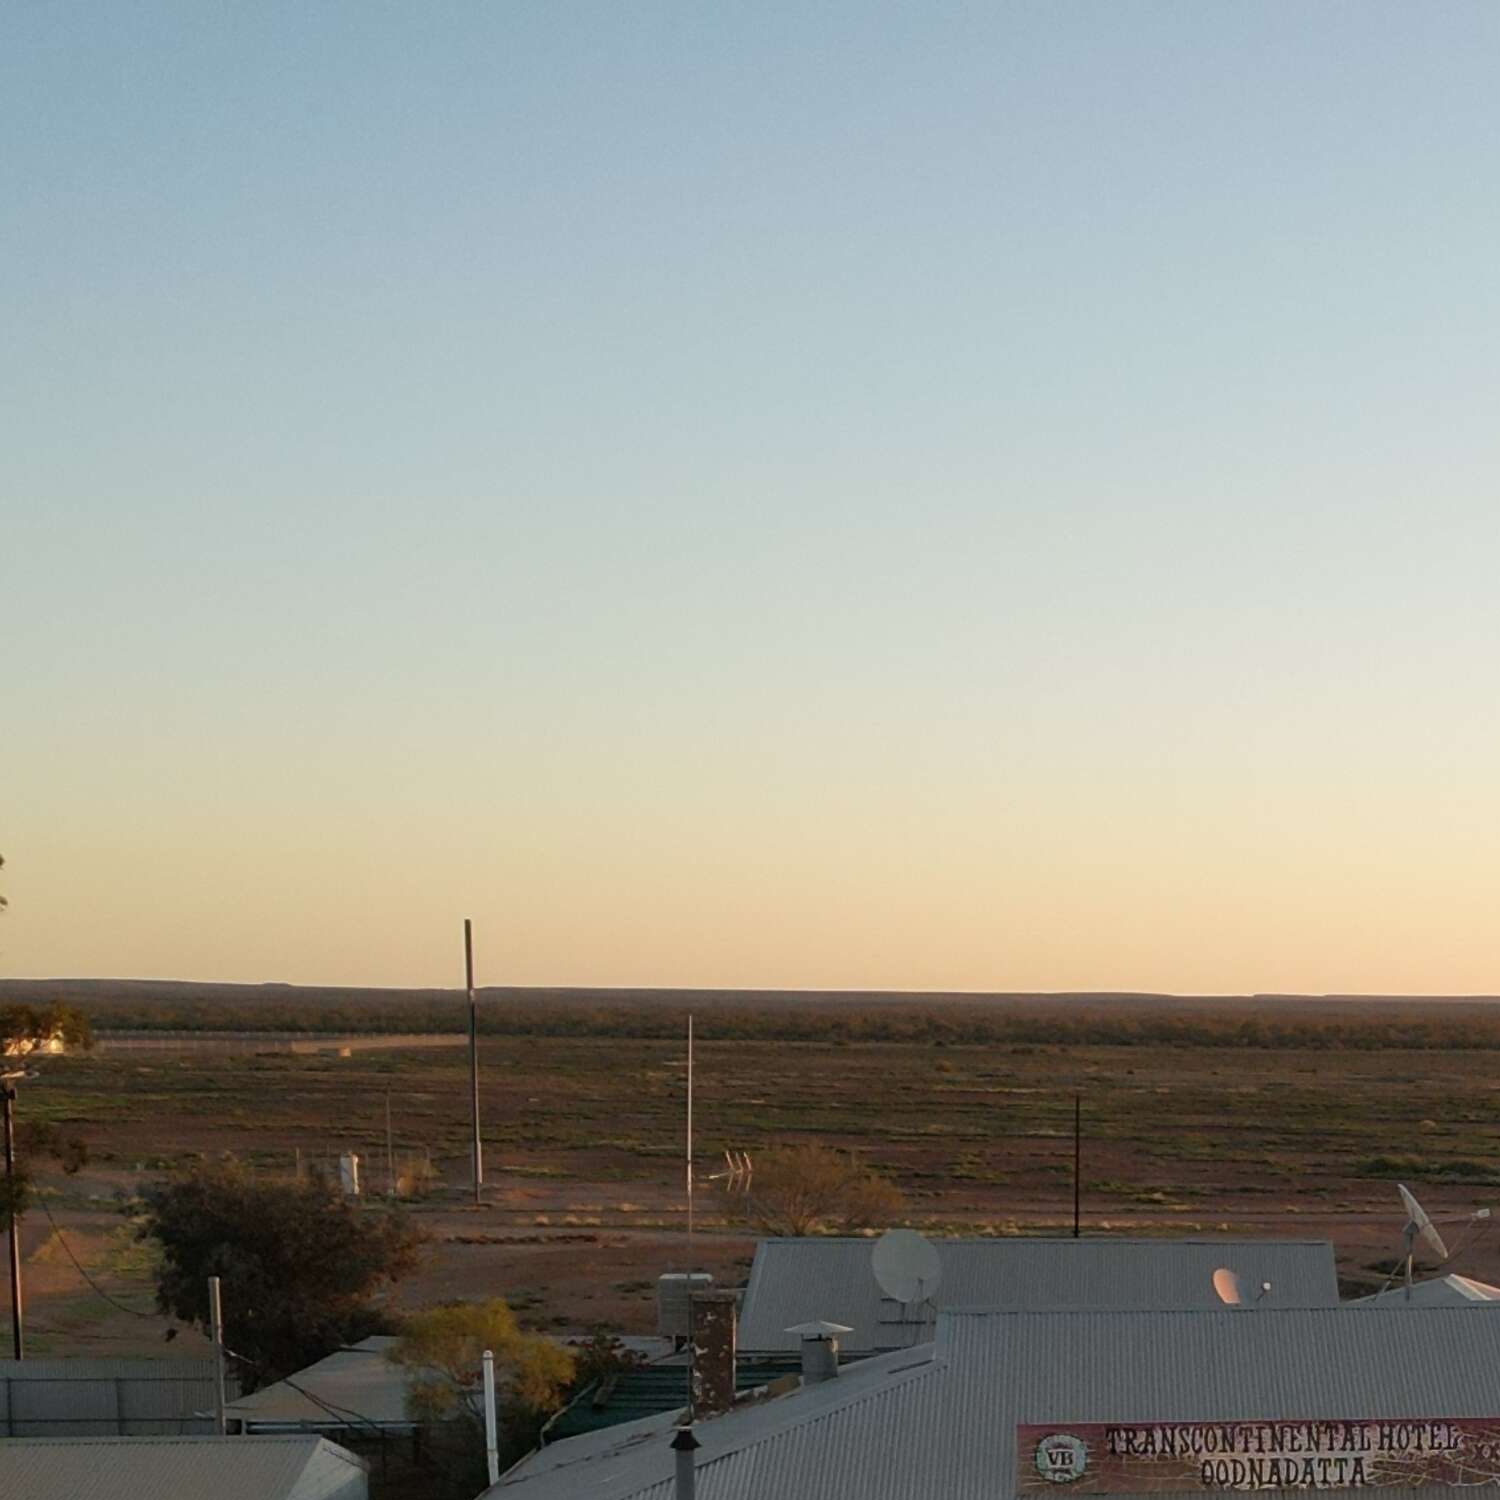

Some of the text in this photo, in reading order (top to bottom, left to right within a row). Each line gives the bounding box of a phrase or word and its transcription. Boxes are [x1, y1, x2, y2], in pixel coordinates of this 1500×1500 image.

[1105, 1422, 1462, 1455] TRANSCONTINENTAL HOTEL
[1201, 1457, 1367, 1488] OODNADATTA
